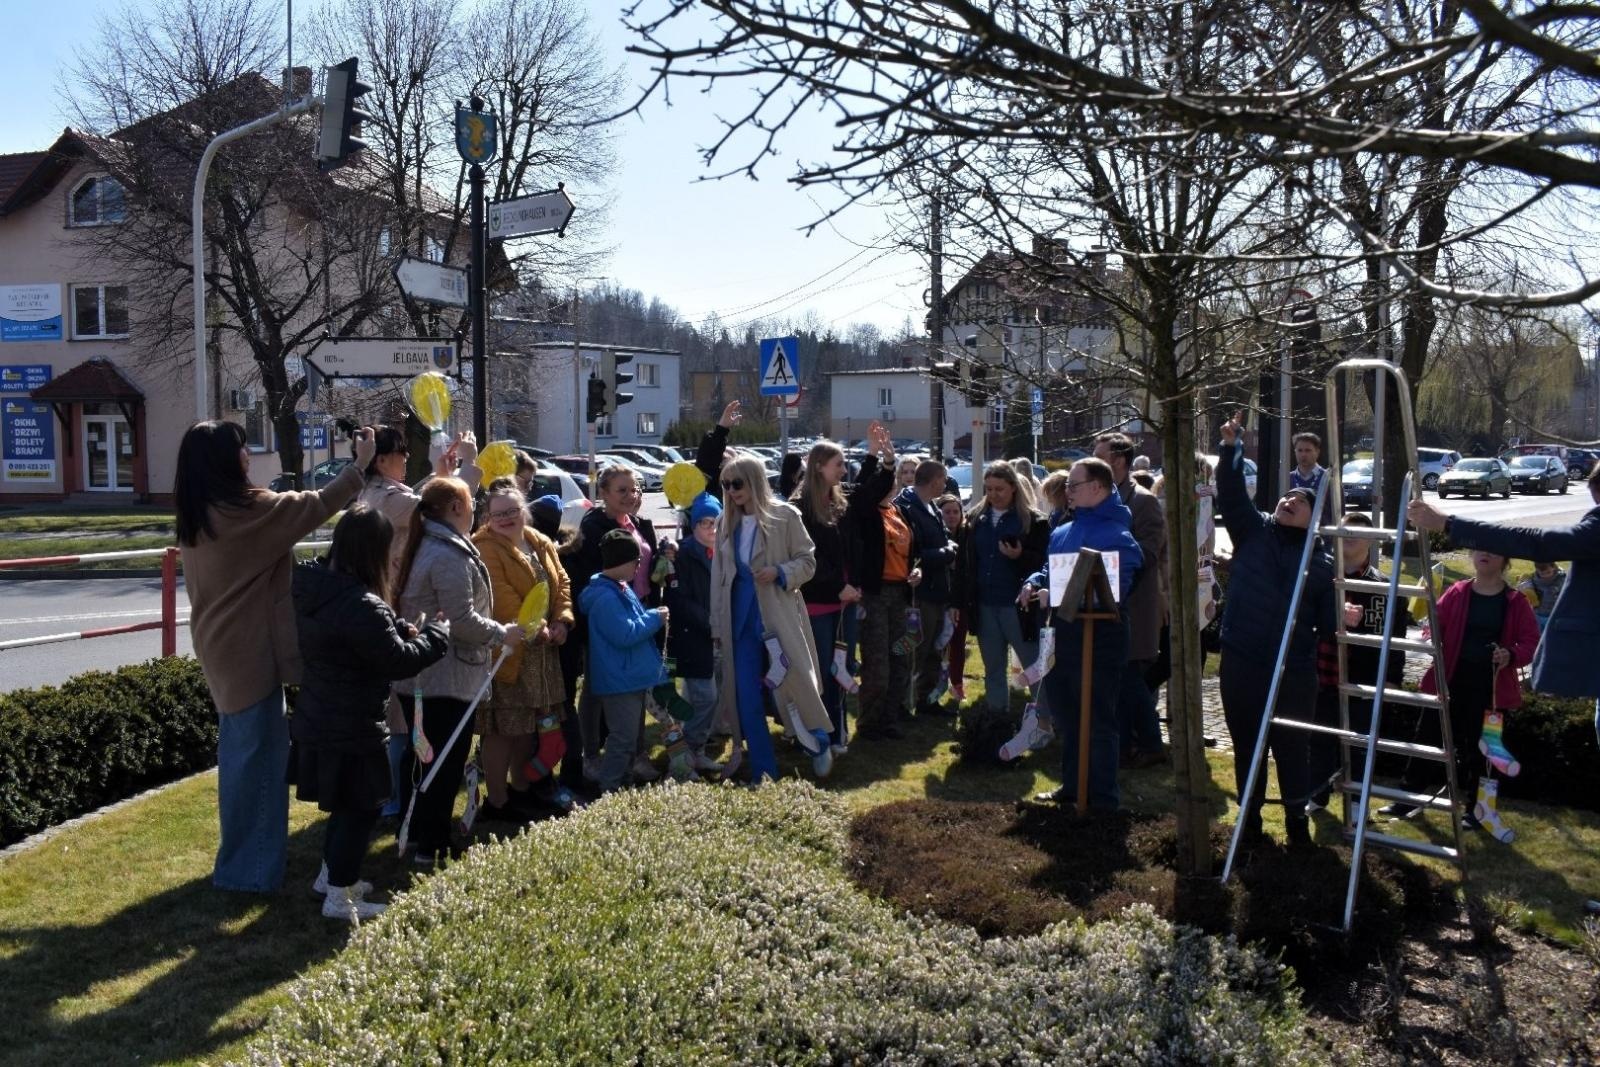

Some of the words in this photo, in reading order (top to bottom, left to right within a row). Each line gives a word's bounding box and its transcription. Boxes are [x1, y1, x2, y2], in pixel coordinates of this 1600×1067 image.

[393, 352, 430, 363] JELGAVA
[14, 418, 37, 427] OKNA
[15, 428, 41, 437] DRZWI
[303, 428, 324, 437] RETY
[15, 438, 46, 447] ROLETY
[15, 447, 44, 456] BRAMY
